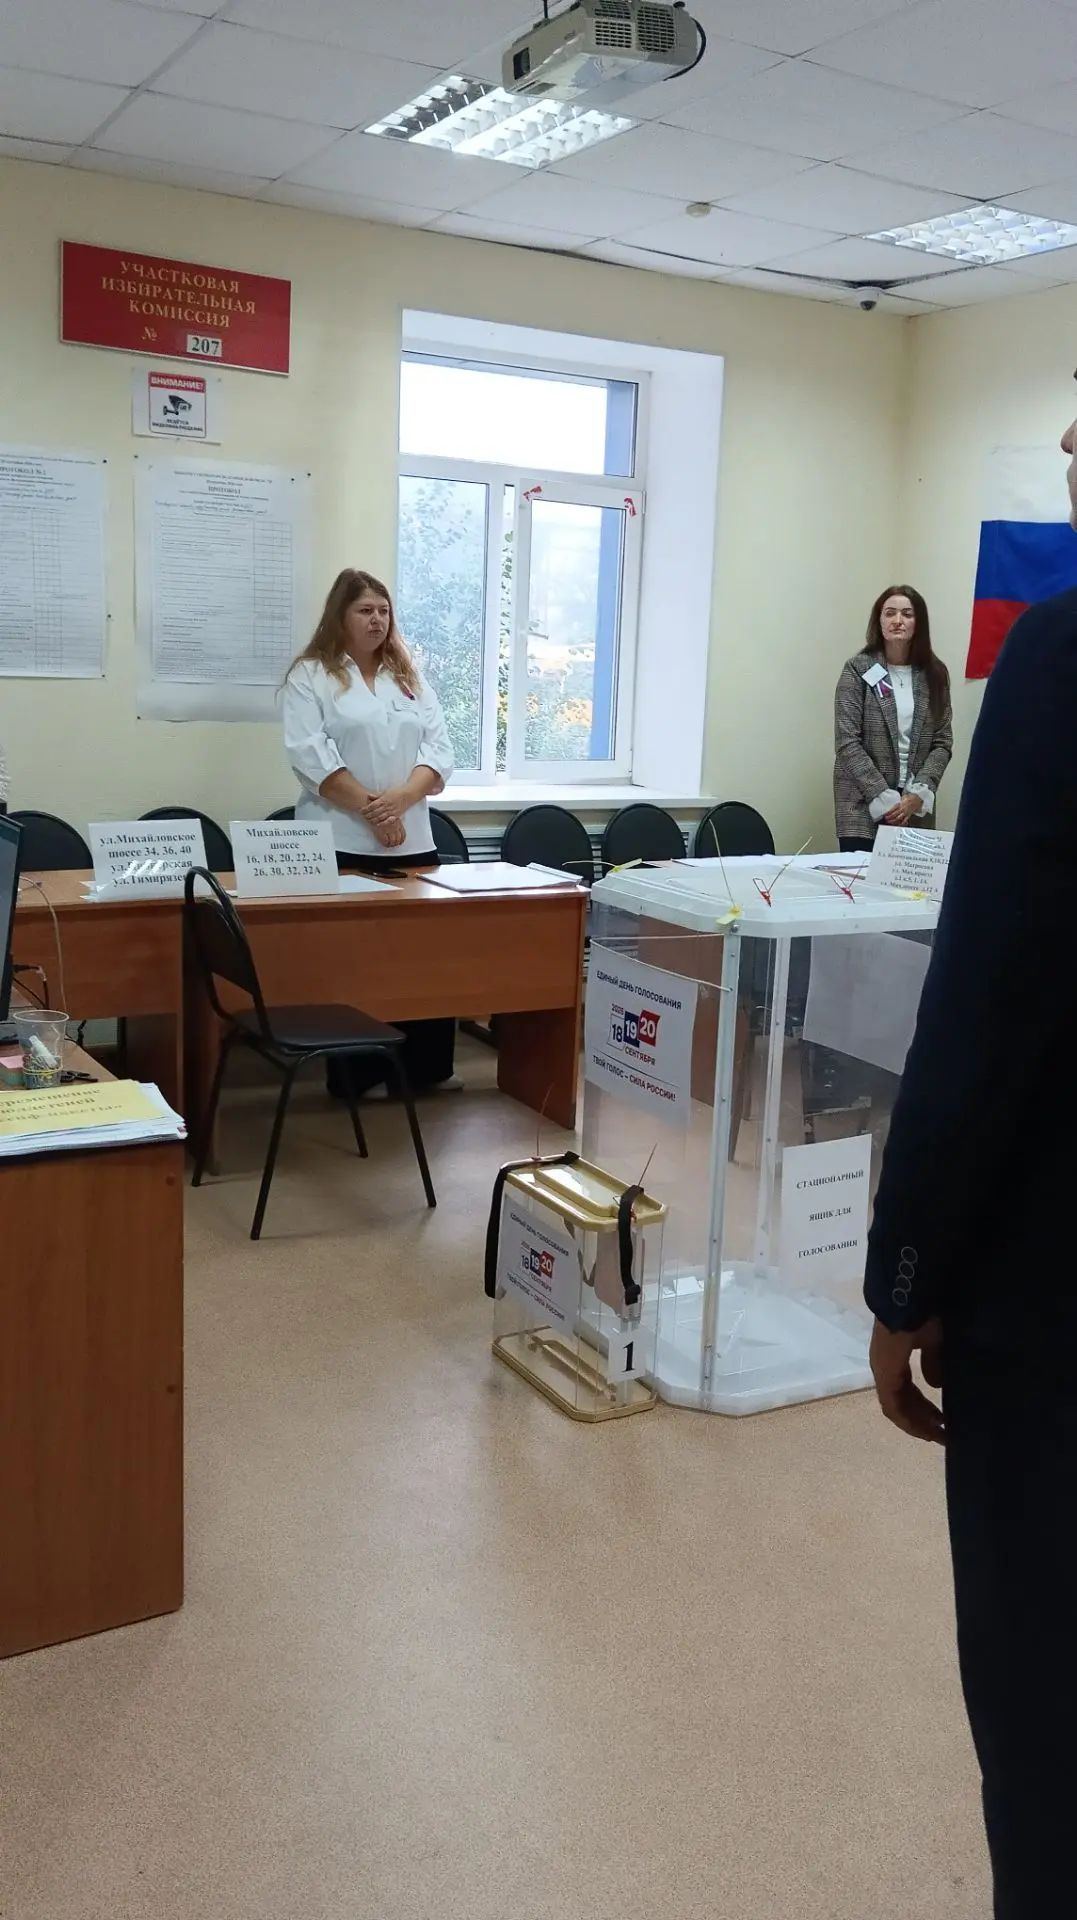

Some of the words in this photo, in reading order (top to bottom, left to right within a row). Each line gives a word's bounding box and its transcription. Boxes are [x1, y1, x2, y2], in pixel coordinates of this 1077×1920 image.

[120, 261, 240, 294] УЧАСТКОВАЯ
[101, 276, 256, 314] ИЗБИРАТЕЛЬНАЯ
[129, 300, 230, 328] КОМИССИЯ
[142, 326, 158, 341] №
[191, 336, 220, 355] 207
[151, 376, 204, 390] ВНИМАНИЕ!
[246, 828, 318, 838] Михайловское
[108, 849, 141, 858] шоссе
[144, 846, 160, 857] 34,
[162, 846, 178, 856] 36,
[180, 845, 192, 854] 40
[270, 842, 300, 850] шоссе
[246, 855, 260, 864] 16,
[264, 854, 277, 863] 18,
[280, 854, 294, 862] 20,
[296, 853, 310, 862] 22,
[312, 852, 326, 861] 24,
[254, 868, 268, 876] 26,
[270, 867, 284, 876] 30,
[287, 866, 300, 875] 32,
[303, 866, 321, 875] 32А
[596, 970, 619, 986] ЕДИНЫЙ
[618, 980, 634, 992] ДЕНЬ
[634, 985, 682, 1010] ГОЛОСОВАНИЯ
[612, 1023, 622, 1042] 18
[626, 1020, 637, 1040] 19
[639, 1018, 656, 1039] 20
[625, 1046, 656, 1066] СЕНТЯБРЯ
[593, 1055, 606, 1069] ТВОЙ
[606, 1062, 624, 1078] ГОЛОС
[630, 1074, 646, 1090] СИЛА
[646, 1080, 676, 1102] РОССИИ!
[796, 1169, 864, 1190] СТАЦИОНАРНЫЙ
[808, 1210, 834, 1222] ЯЩИК
[834, 1206, 852, 1217] ДЛЯ
[798, 1240, 858, 1258] ГОЛОСОВАНИЯ
[521, 1254, 530, 1270] 18
[531, 1254, 540, 1270] 19
[540, 1254, 552, 1272] 20
[622, 1340, 636, 1373] 1
